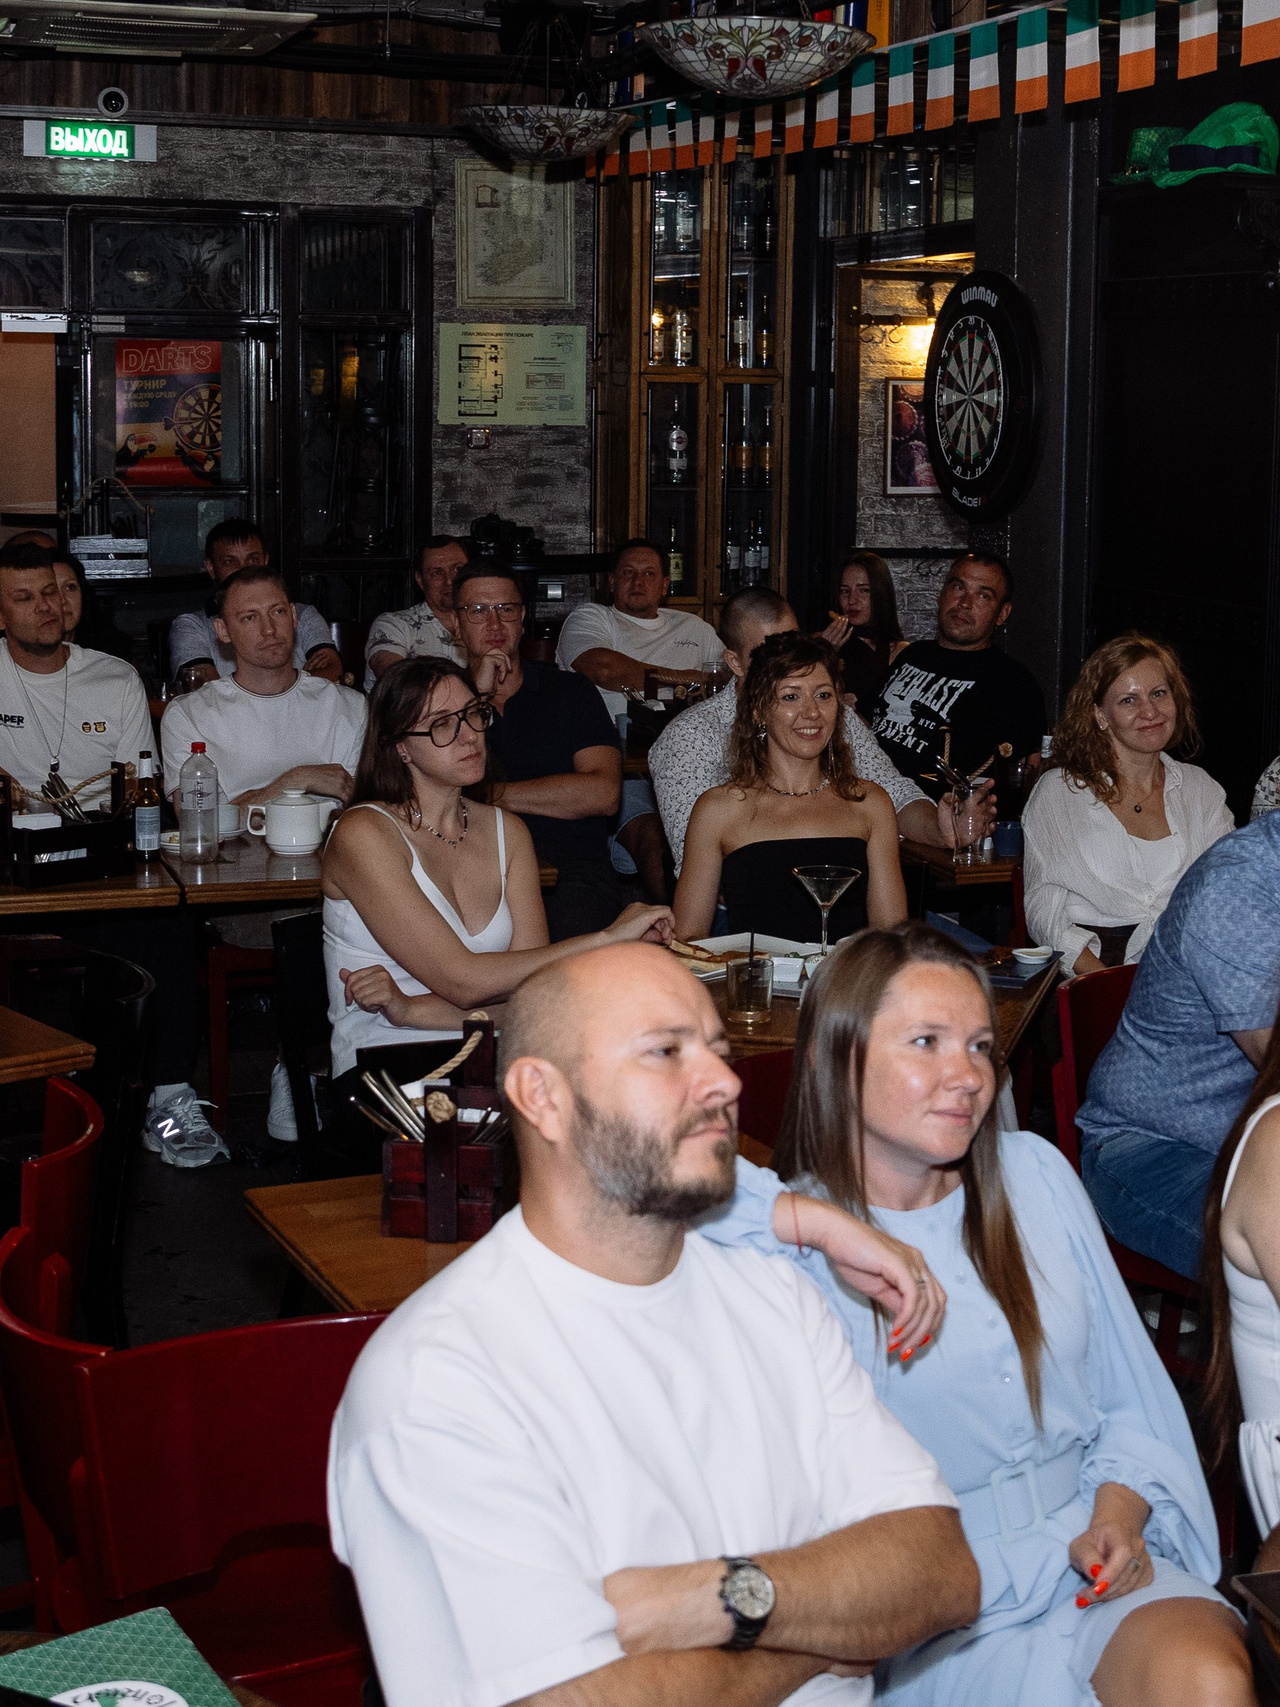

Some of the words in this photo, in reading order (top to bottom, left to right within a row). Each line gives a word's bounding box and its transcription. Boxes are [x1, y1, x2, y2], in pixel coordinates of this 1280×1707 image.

[50, 126, 129, 157] ВЫХОД
[961, 286, 998, 308] WINMAU
[123, 344, 212, 373] DARTS
[122, 379, 167, 391] ТУРНИР
[917, 718, 936, 730] NYC
